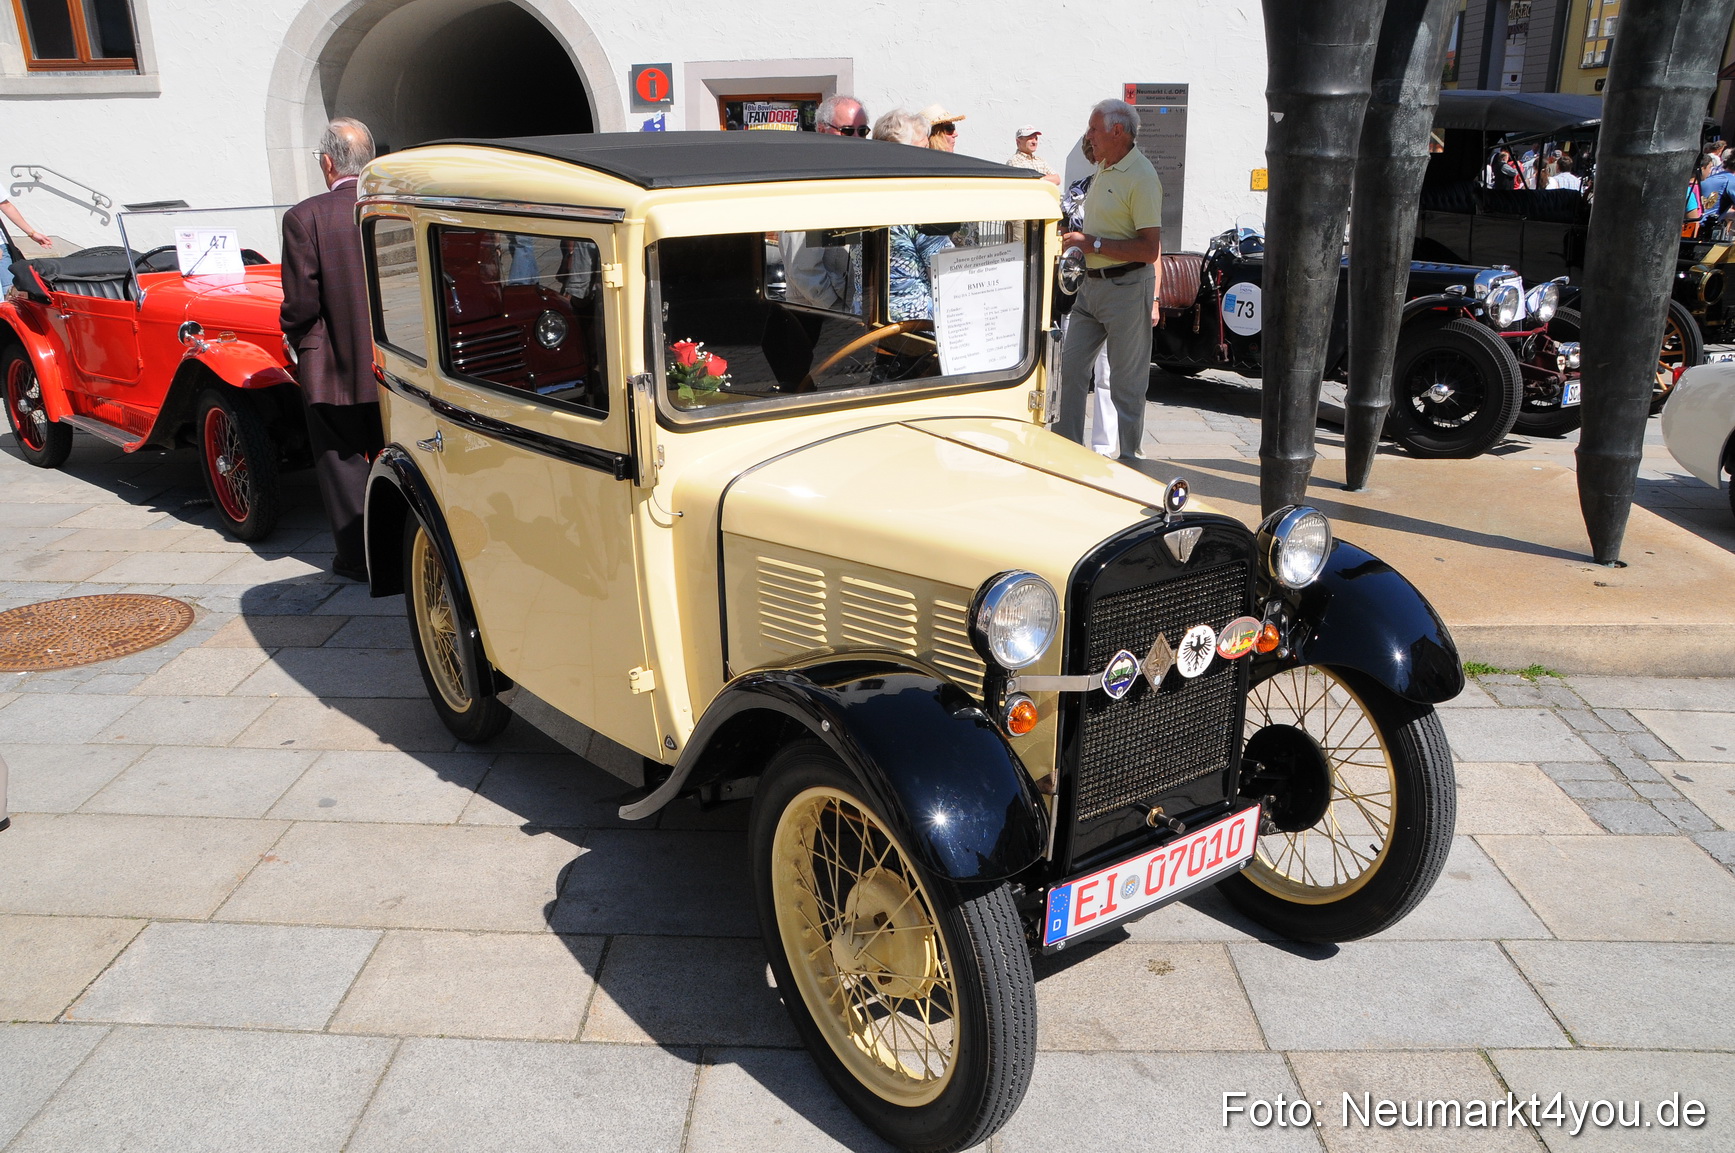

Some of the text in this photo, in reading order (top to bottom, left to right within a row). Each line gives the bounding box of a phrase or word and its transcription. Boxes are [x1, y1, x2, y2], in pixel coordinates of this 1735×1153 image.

[748, 110, 798, 122] FANDORF
[968, 282, 986, 290] BMW
[1236, 300, 1254, 318] 73
[1074, 818, 1245, 926] EI 07010
[1053, 919, 1061, 931] D
